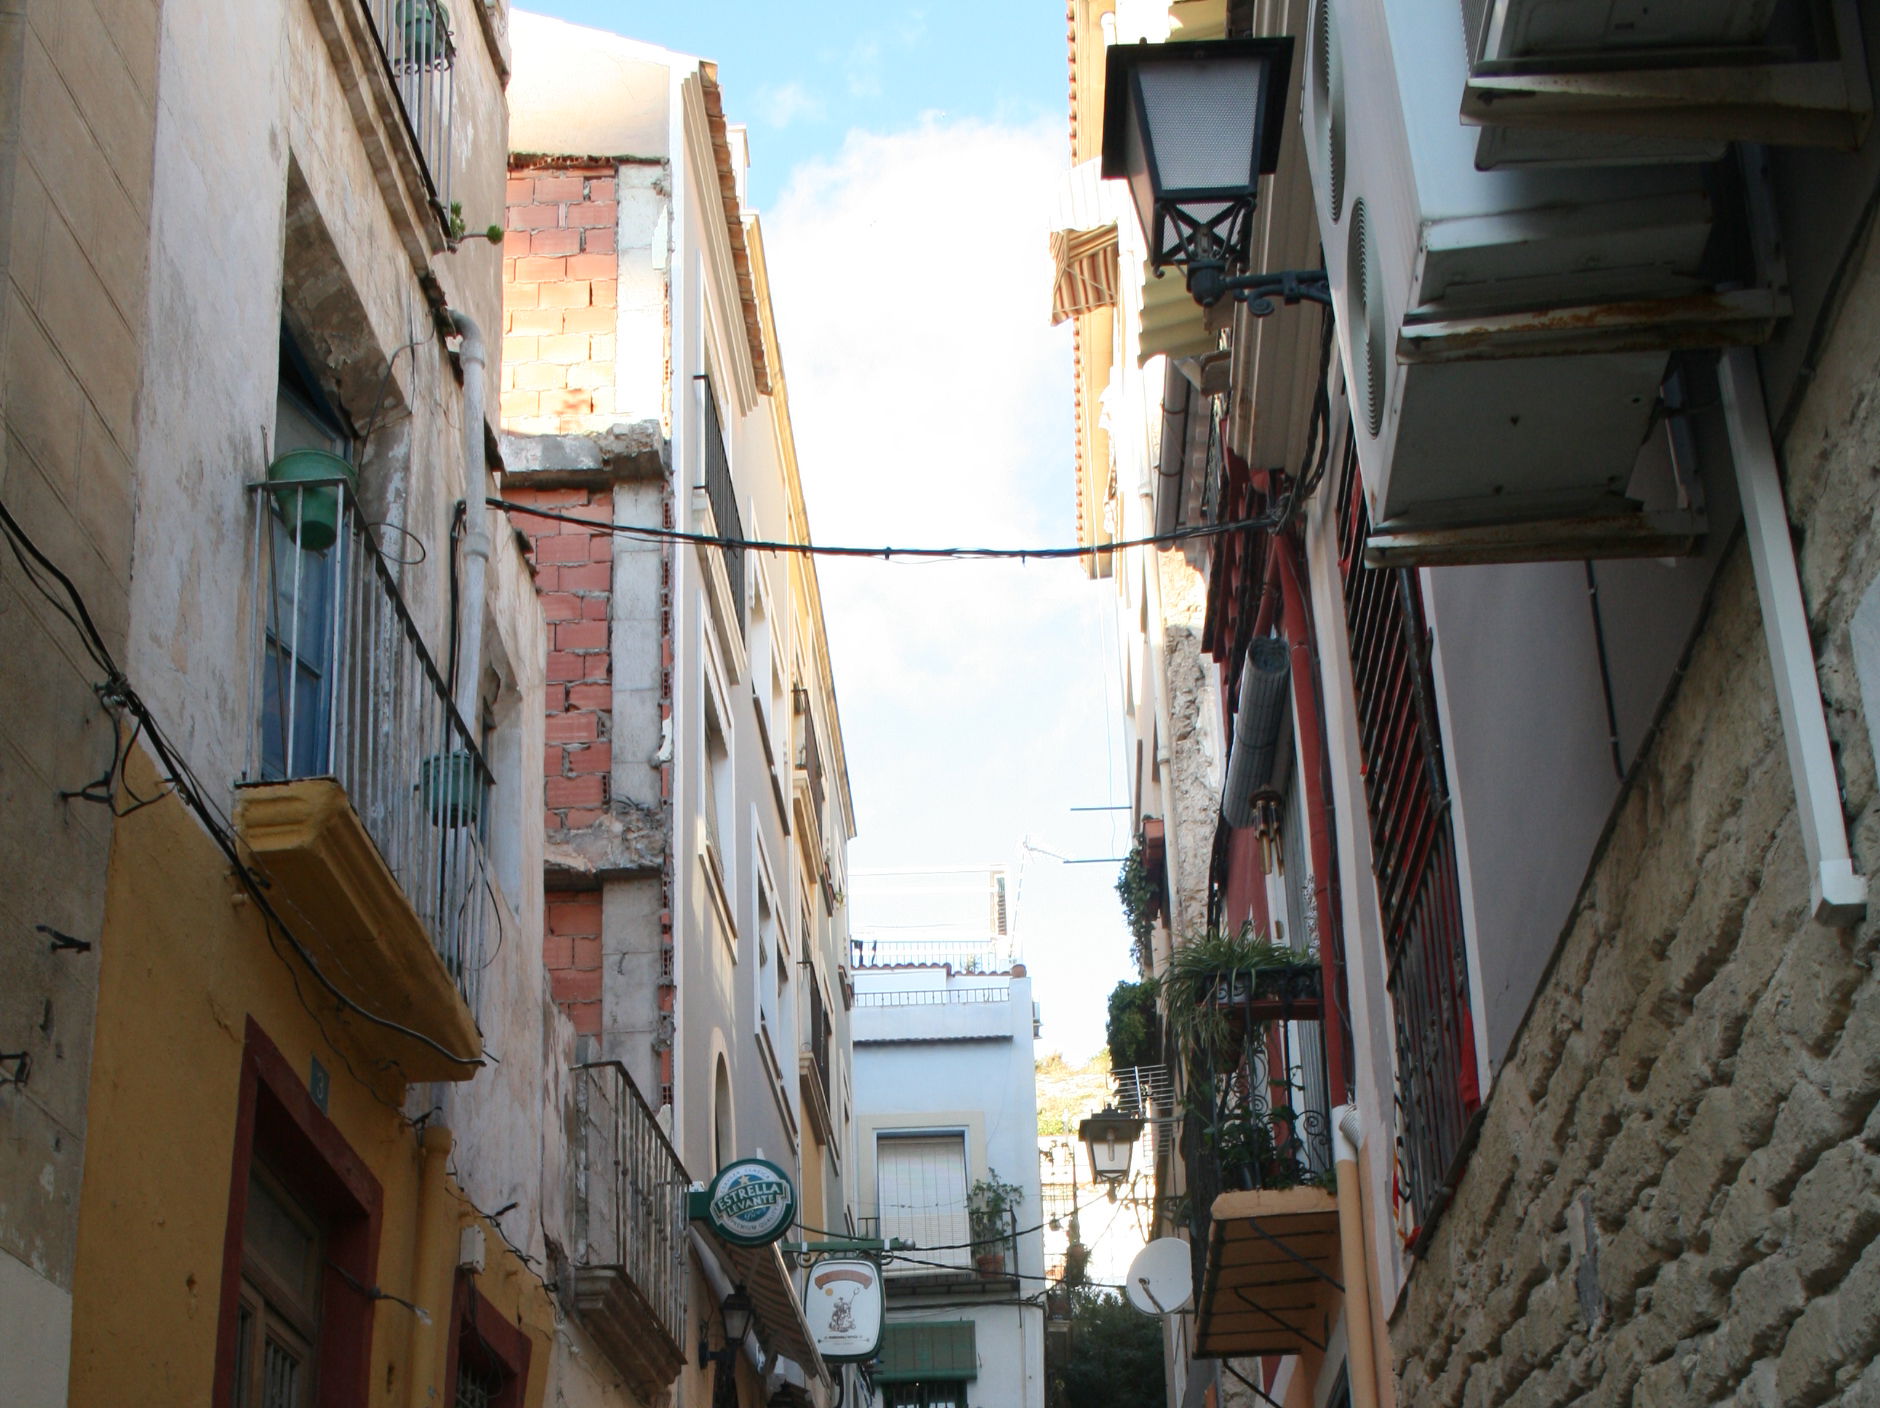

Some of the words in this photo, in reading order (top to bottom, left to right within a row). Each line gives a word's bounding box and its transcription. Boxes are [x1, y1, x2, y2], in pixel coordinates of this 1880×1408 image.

[316, 1072, 324, 1099] 3
[717, 1183, 781, 1210] ESTRELLA
[727, 1194, 775, 1216] LEVANTE
